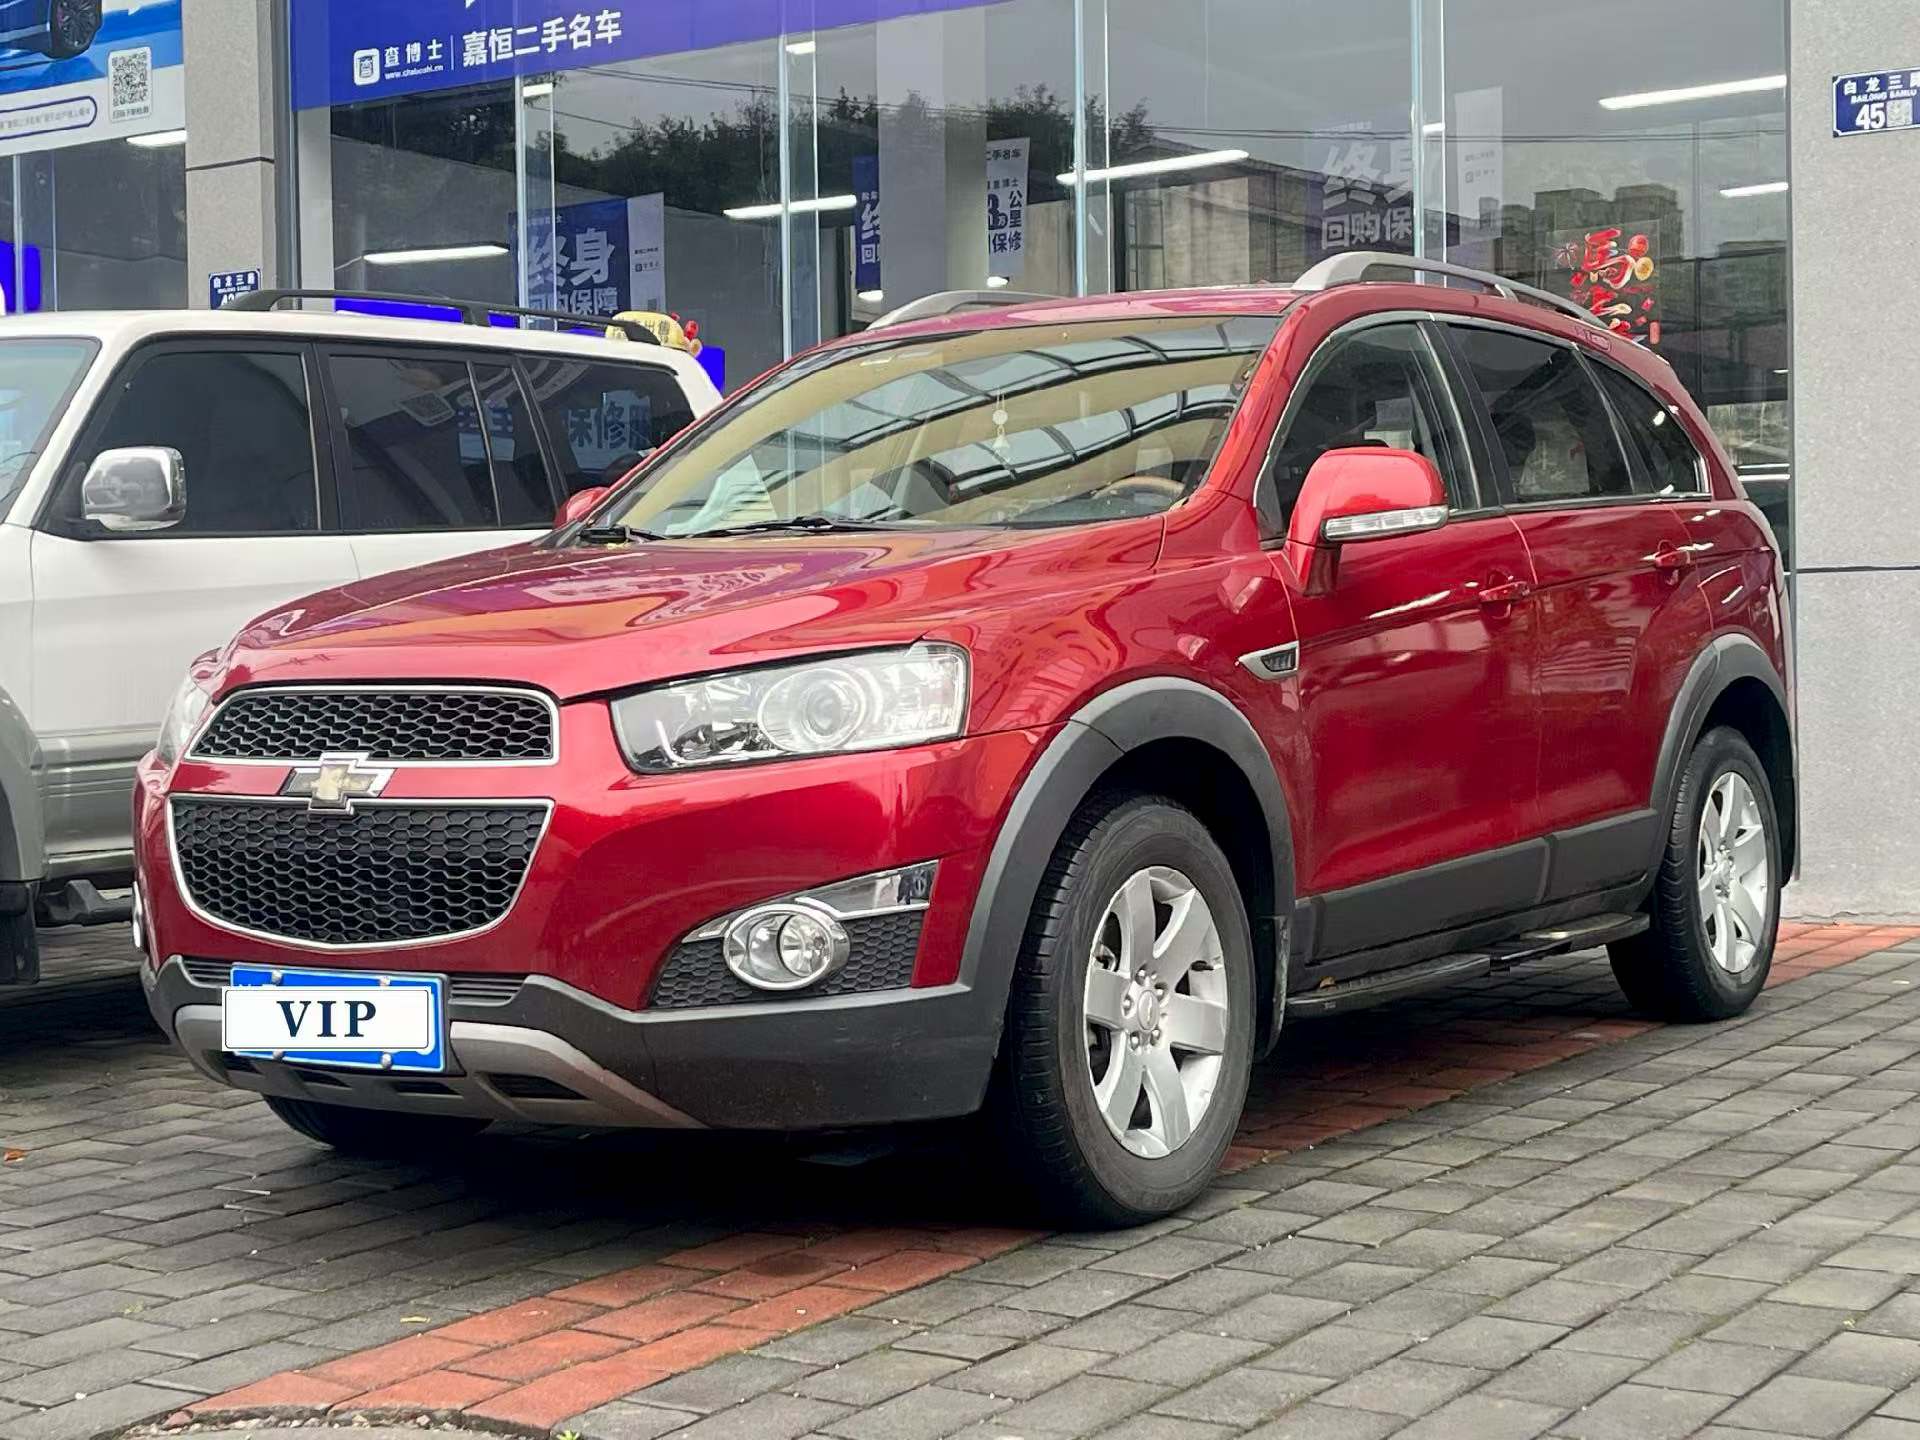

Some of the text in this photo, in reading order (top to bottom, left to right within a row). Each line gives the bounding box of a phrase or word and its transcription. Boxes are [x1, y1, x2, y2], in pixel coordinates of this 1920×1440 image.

[461, 8, 623, 68] 嘉恒二手名车
[384, 38, 443, 68] 查博士
[1855, 102, 1886, 130] 45
[988, 232, 1022, 255] 保修
[1320, 206, 1438, 252] 回购保
[861, 243, 880, 265] 回
